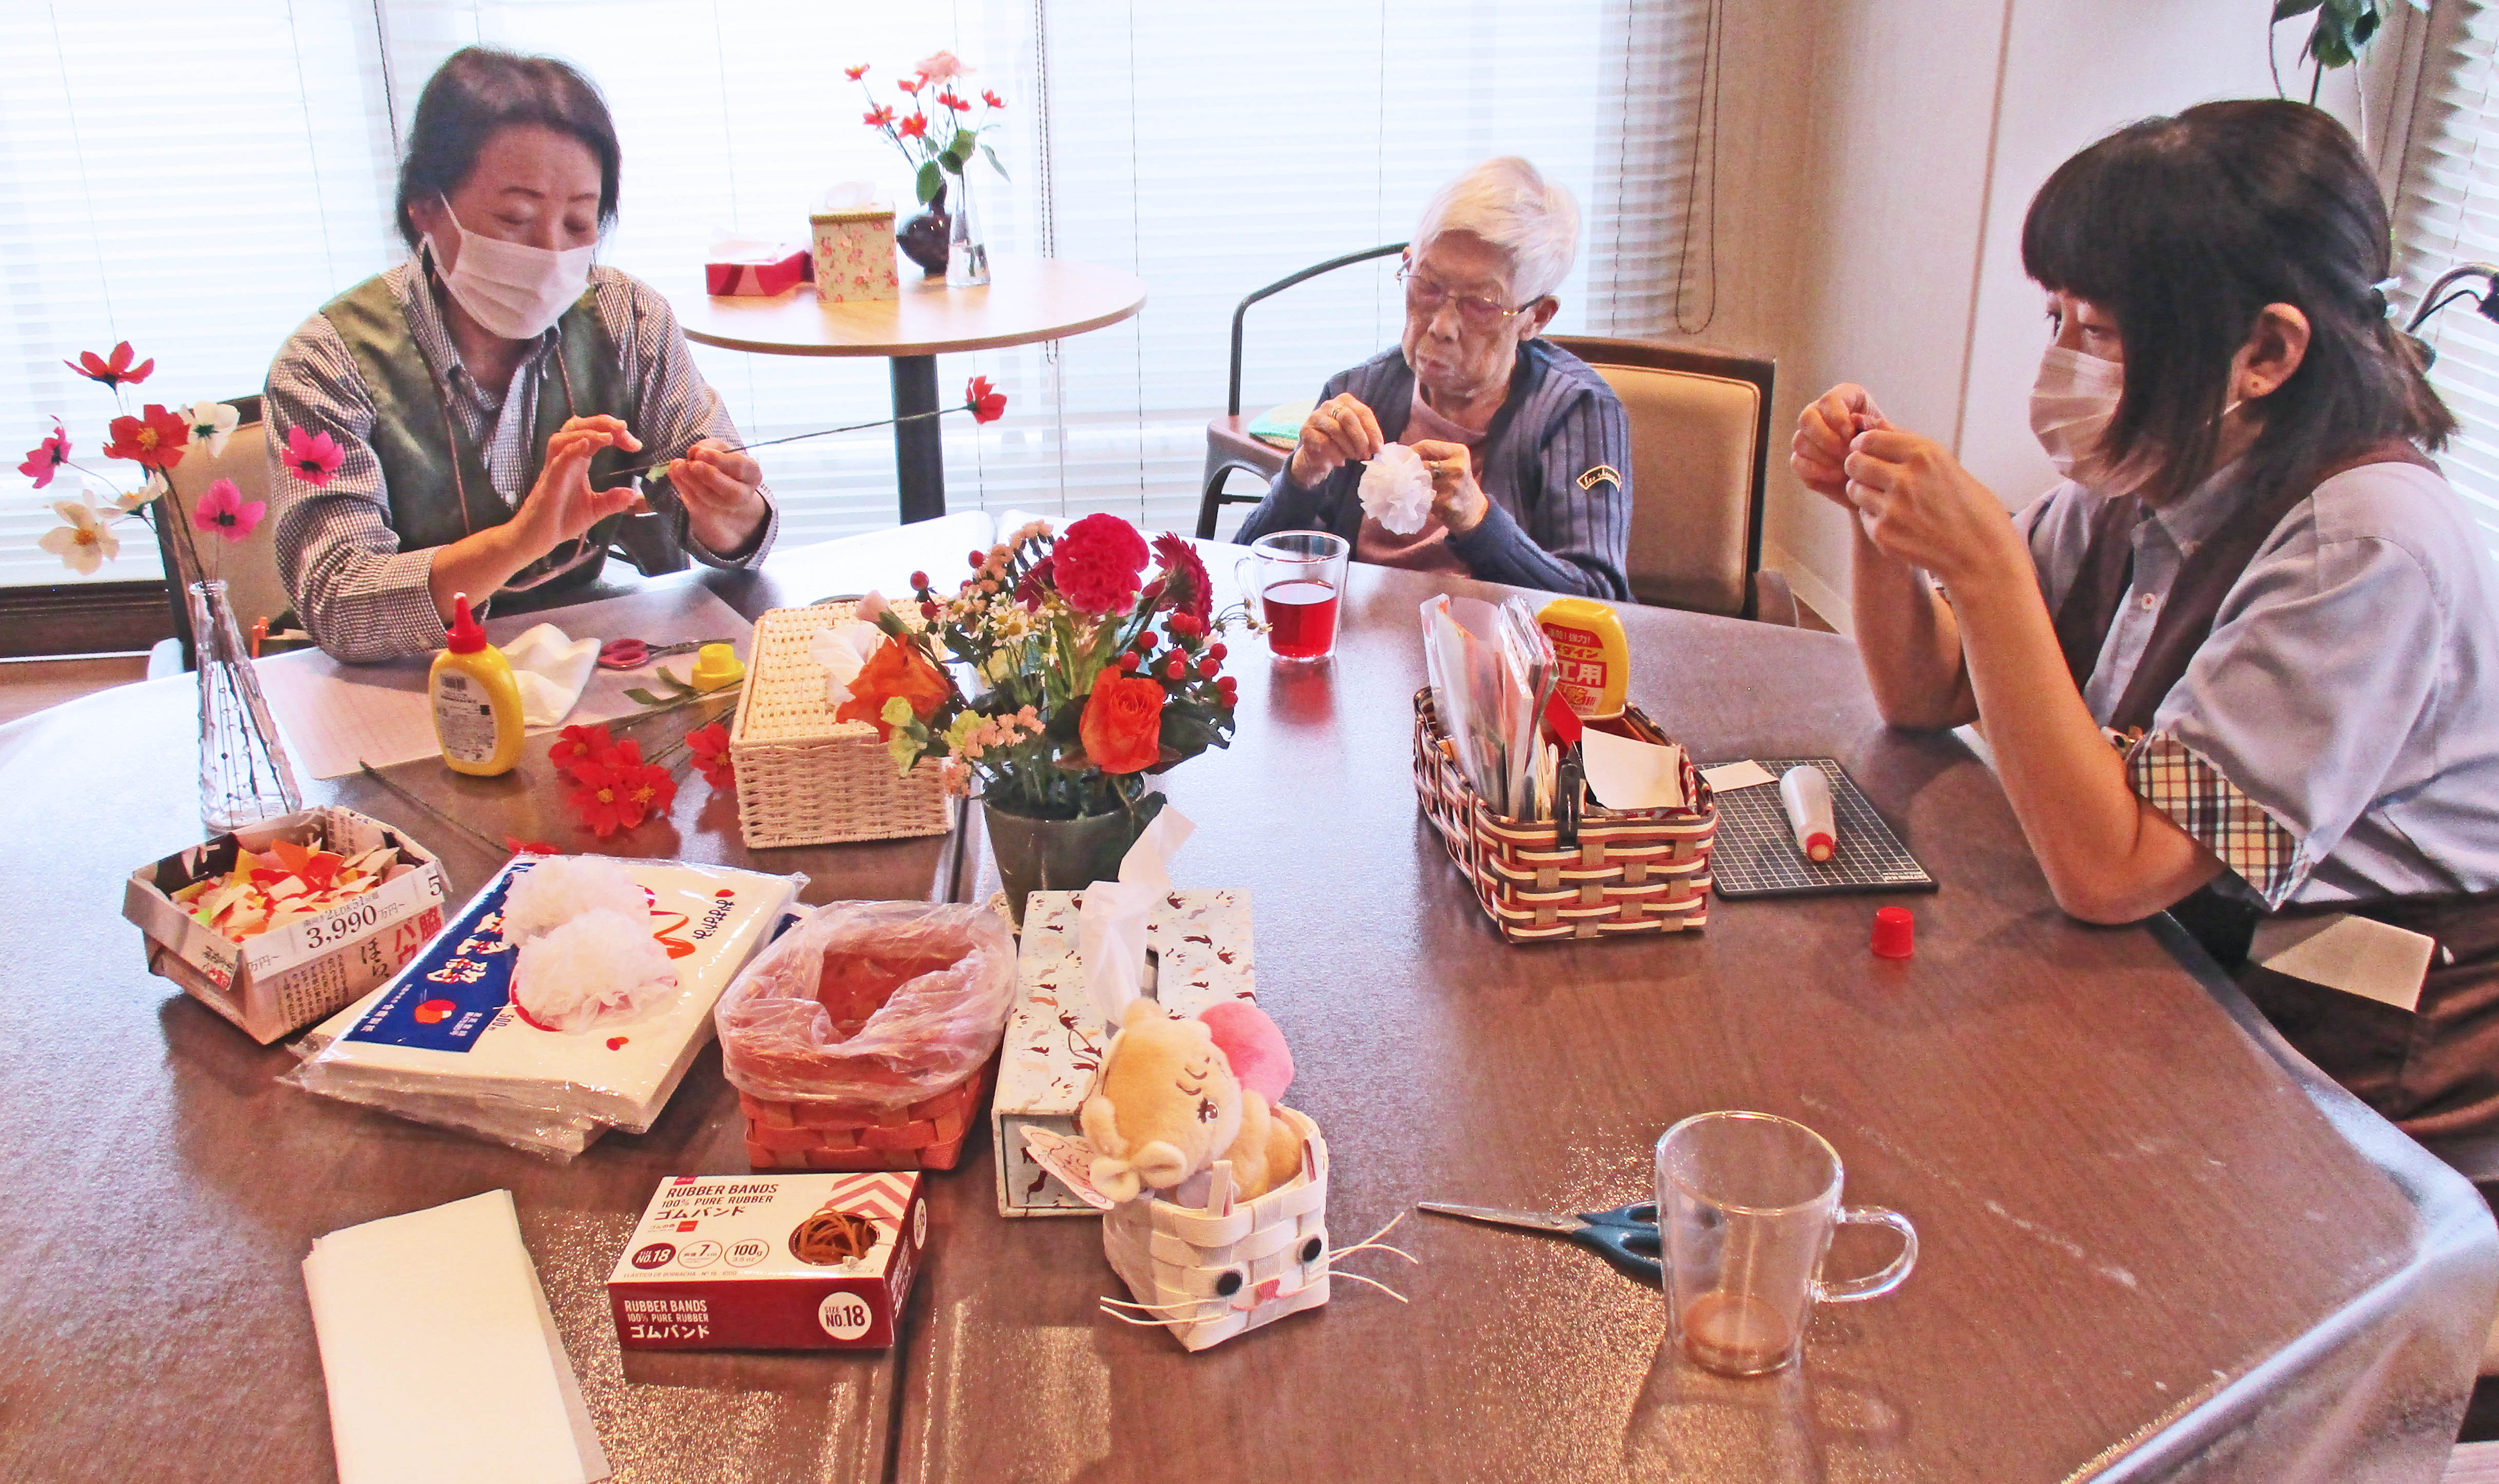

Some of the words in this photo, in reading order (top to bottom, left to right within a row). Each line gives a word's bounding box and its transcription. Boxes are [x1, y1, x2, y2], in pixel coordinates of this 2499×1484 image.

[666, 1185, 725, 1198] RUBBER
[728, 1184, 779, 1194] BANDS
[662, 1199, 689, 1208] 100%
[694, 1197, 724, 1206] PURE
[728, 1195, 774, 1204] RUBBER
[654, 1206, 746, 1220] ゴムバンド
[635, 1249, 671, 1264] NO.18
[734, 1244, 762, 1256] 100g
[624, 1300, 668, 1312] RUBBER
[670, 1300, 707, 1312] BANDS
[627, 1313, 649, 1322] 100%
[651, 1313, 673, 1322] PURE
[676, 1313, 709, 1322] RUBBER
[825, 1305, 866, 1327] NO.18
[630, 1324, 710, 1339] ゴムバンド
